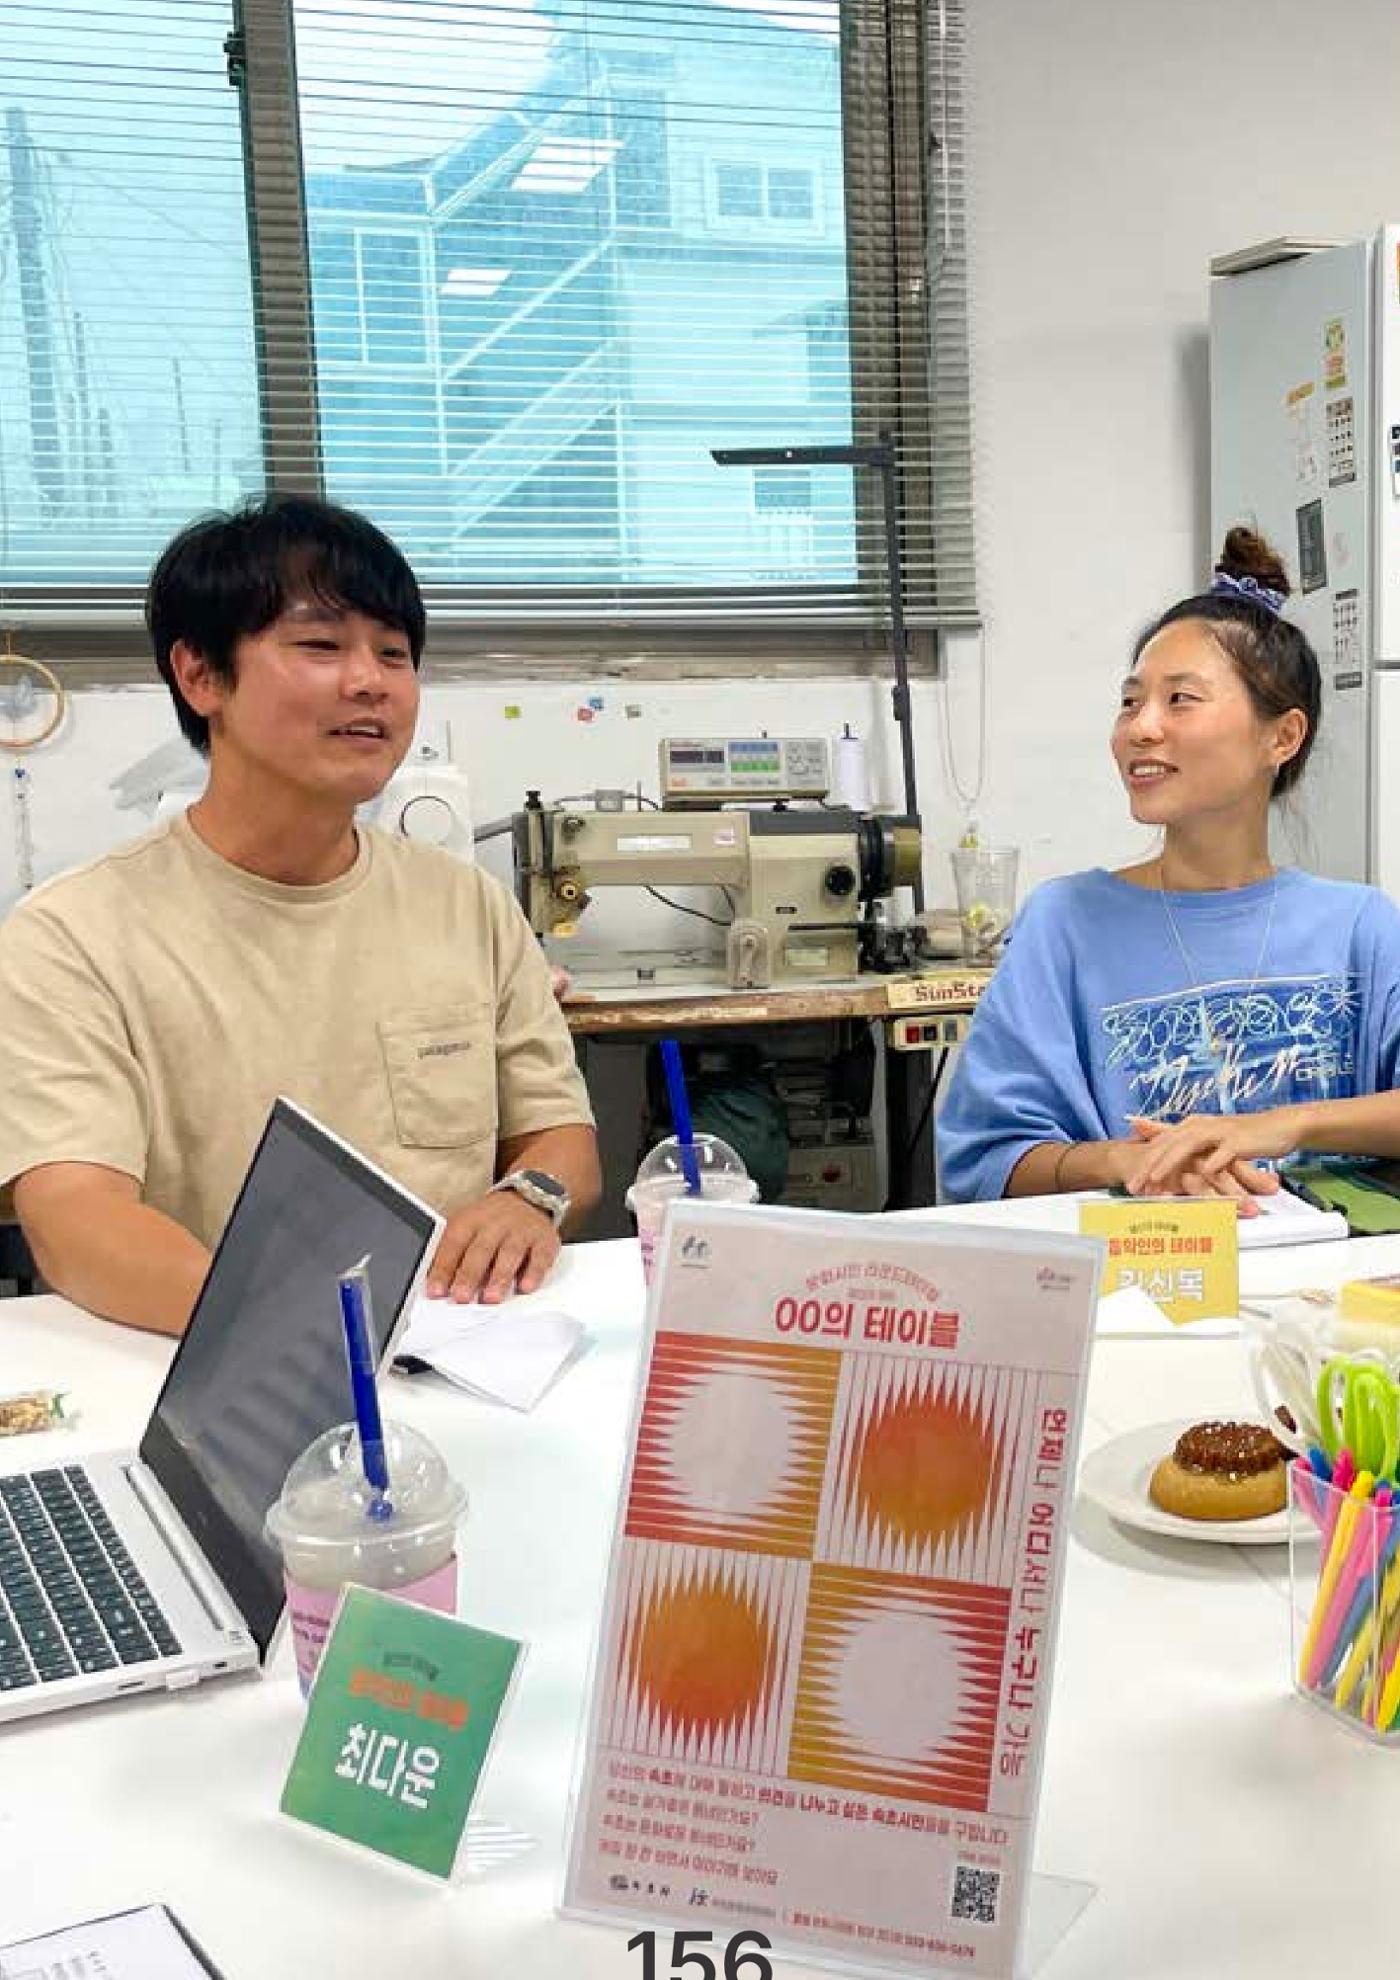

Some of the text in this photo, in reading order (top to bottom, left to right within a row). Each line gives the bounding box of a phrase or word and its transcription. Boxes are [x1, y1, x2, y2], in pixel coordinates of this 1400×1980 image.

[863, 1305, 960, 1350] 테이블
[999, 1409, 1068, 1777] 언제나 어디서나 누구나 가능
[335, 1722, 440, 1809] 최다운
[800, 1794, 839, 1815] 나누고
